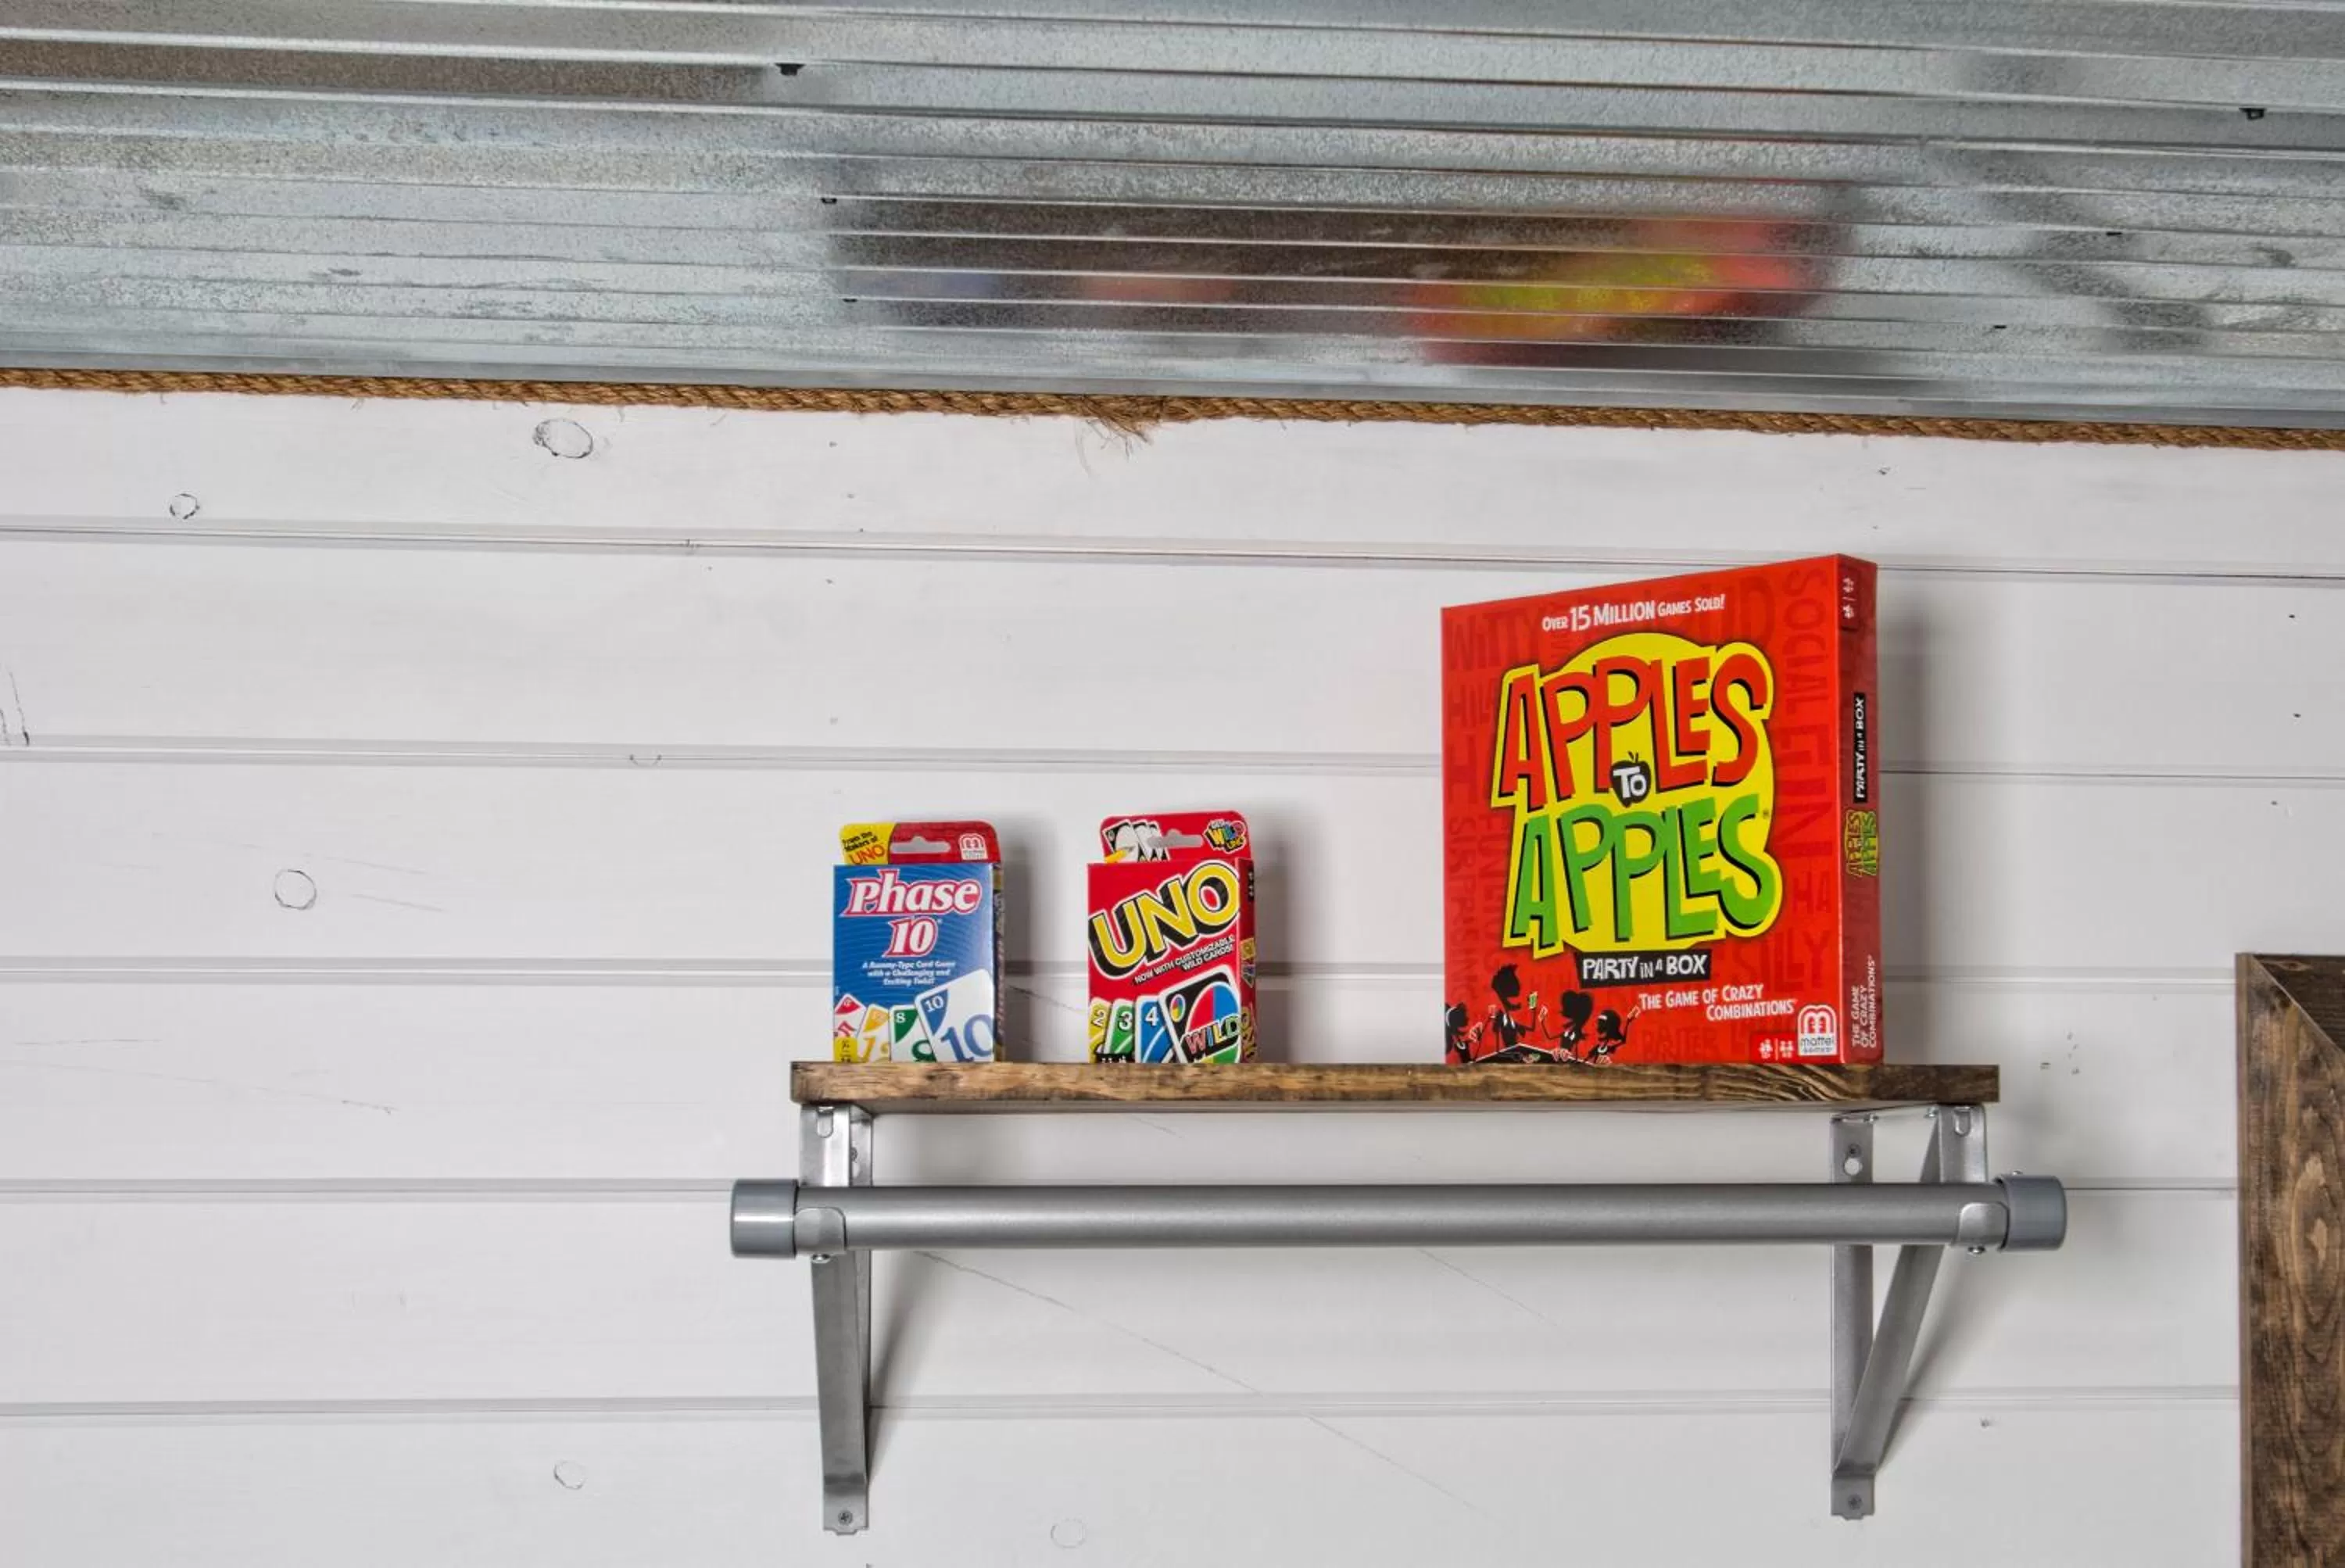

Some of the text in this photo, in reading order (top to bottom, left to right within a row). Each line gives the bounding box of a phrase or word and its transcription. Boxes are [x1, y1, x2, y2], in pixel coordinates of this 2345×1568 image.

[1542, 593, 1726, 632] OVER 15 MILLION GAMES SOLD!
[1855, 697, 1864, 729] BOX
[1498, 653, 1768, 811] APPLES
[1613, 765, 1647, 797] TO
[1854, 751, 1865, 799] PARTY
[849, 844, 885, 864] UNO
[1511, 793, 1777, 950] APPLES
[842, 869, 982, 916] Phase
[1090, 861, 1240, 976] UNO
[883, 917, 937, 957] 10
[1134, 970, 1155, 984] NOW
[1182, 957, 1203, 971] WILD
[1582, 956, 1639, 980] PARTY
[1655, 958, 1663, 972] A
[1666, 954, 1708, 976] BOX
[925, 995, 943, 1012] 10
[1638, 983, 1764, 1011] THE GAME OF CRAZY
[1092, 1008, 1107, 1027] 2
[1119, 1011, 1132, 1031] 3
[1145, 1005, 1159, 1026] 4
[1851, 985, 1860, 1047] THE GAME
[1184, 1015, 1241, 1054] WILD
